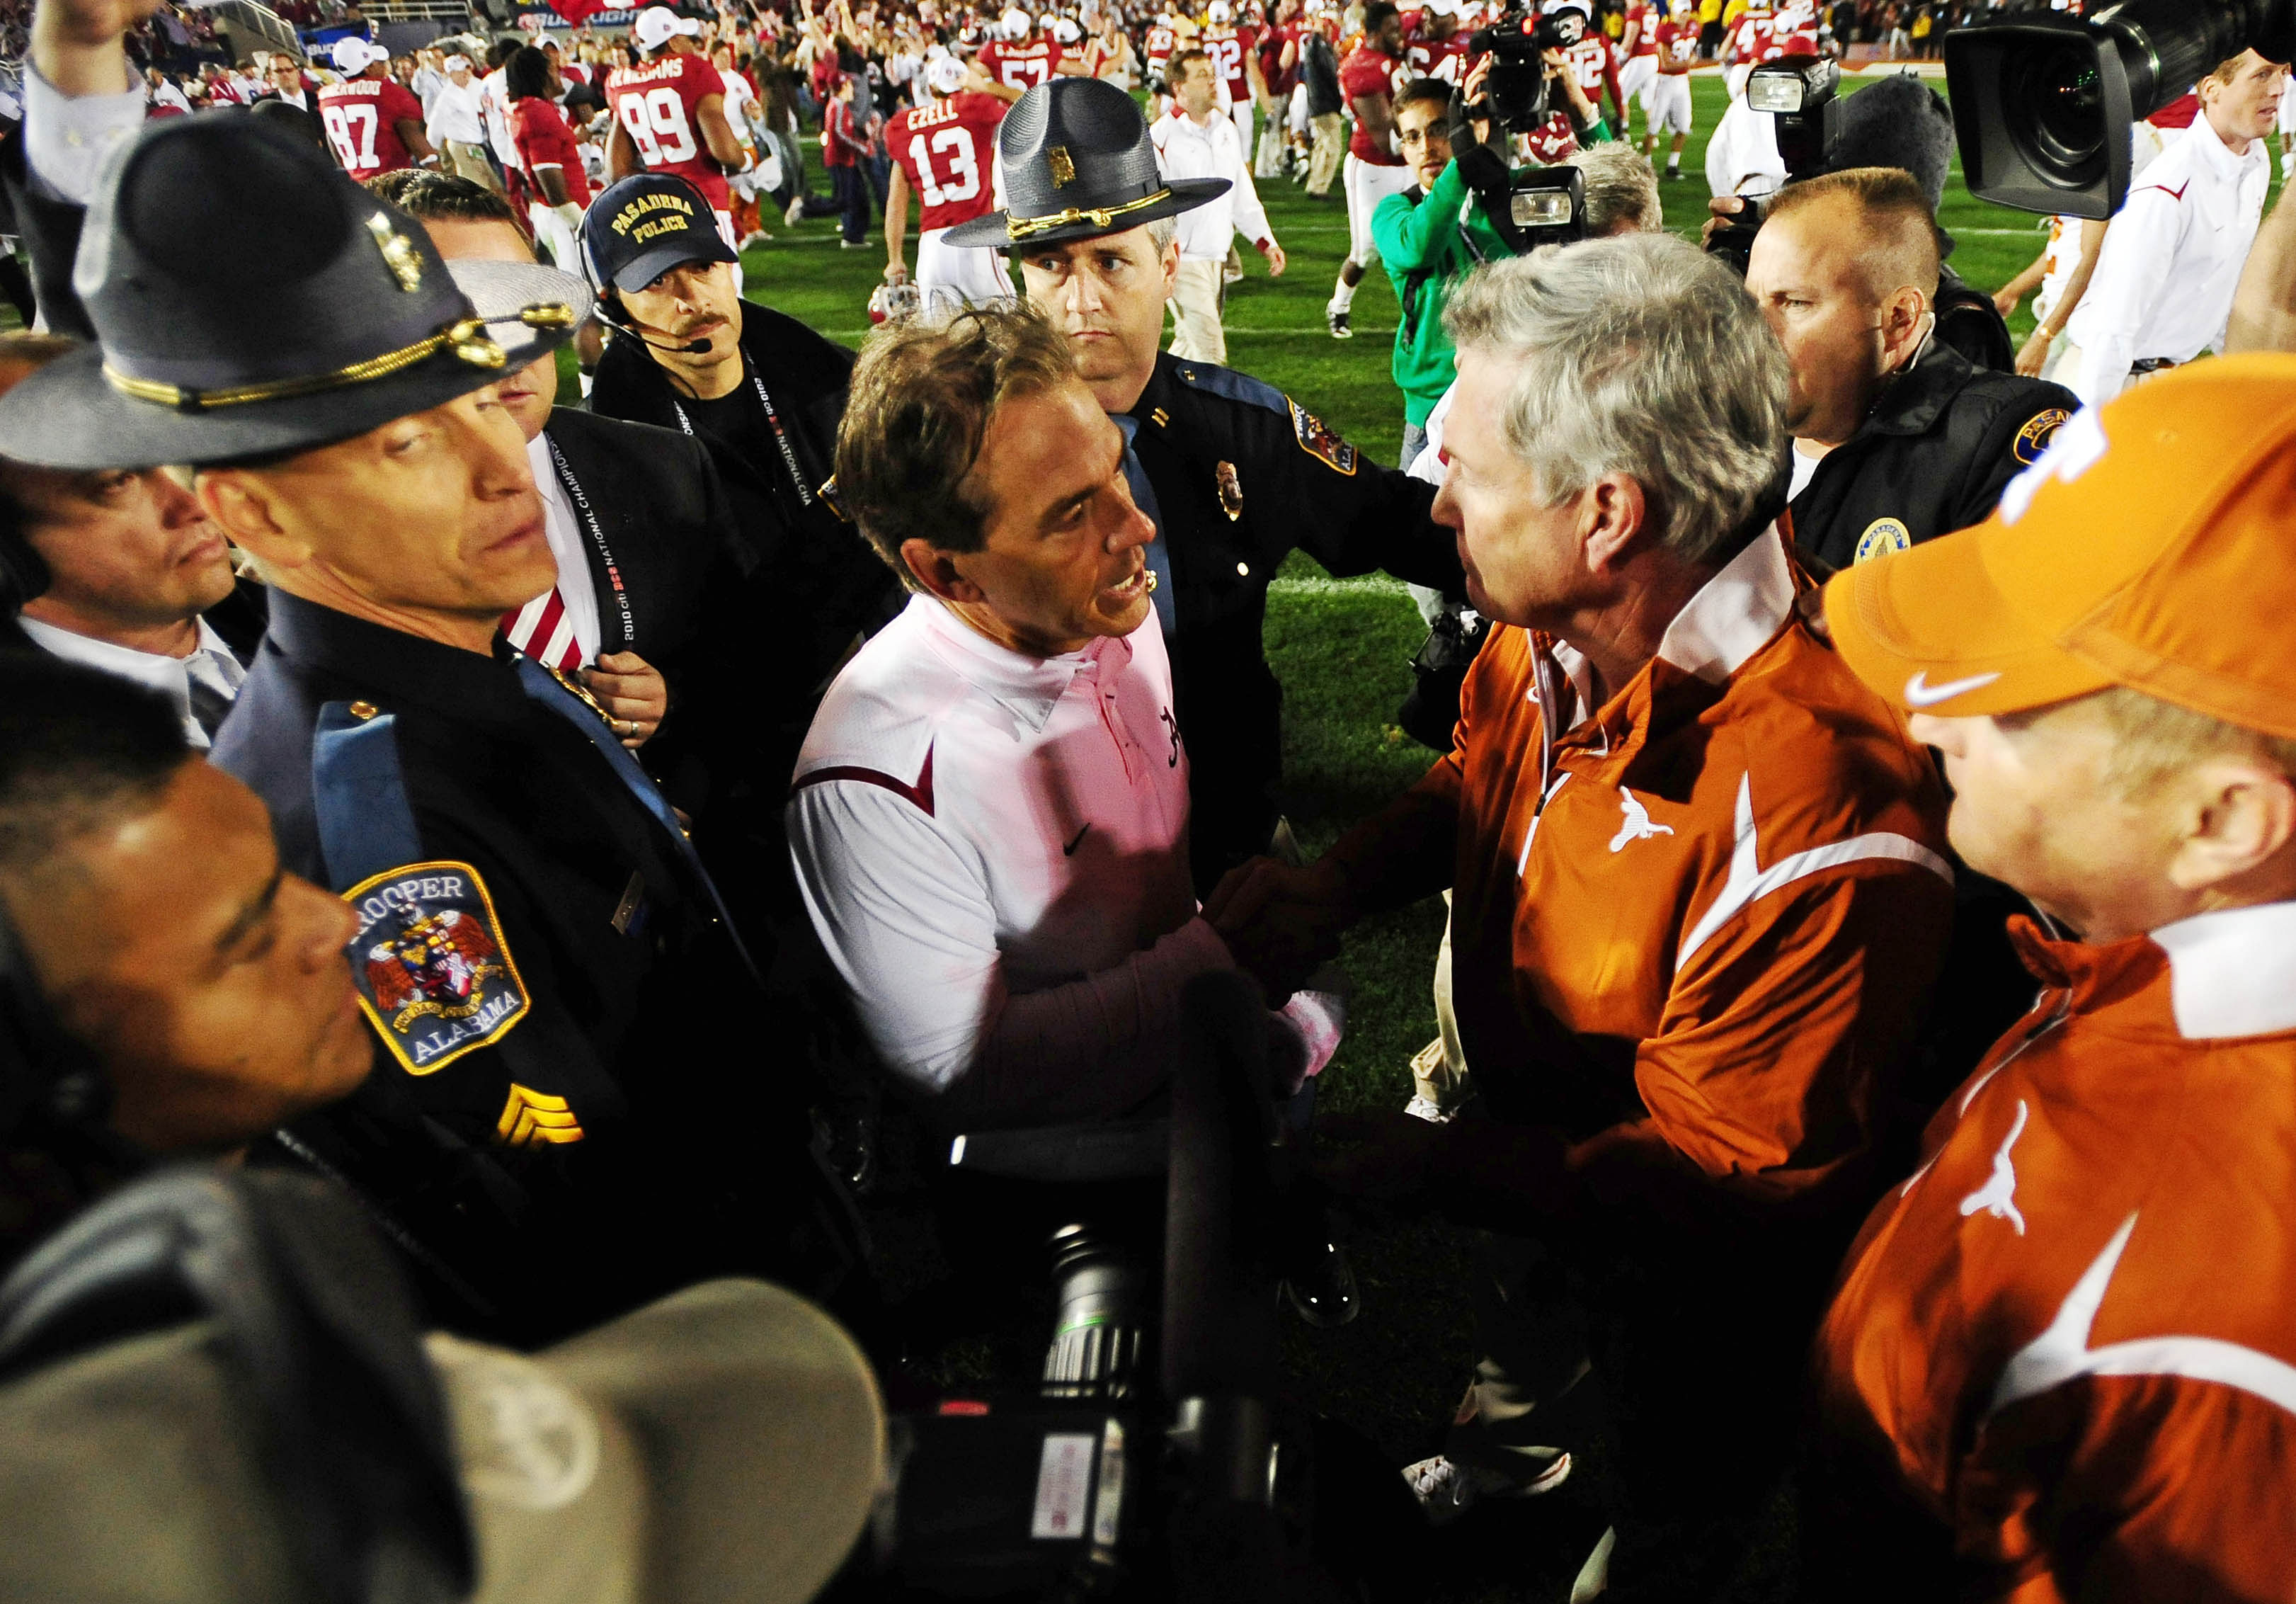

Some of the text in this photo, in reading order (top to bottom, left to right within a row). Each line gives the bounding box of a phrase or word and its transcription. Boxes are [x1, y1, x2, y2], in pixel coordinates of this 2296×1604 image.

[1001, 57, 1048, 92] 57
[323, 103, 380, 170] 87
[619, 87, 697, 166] 89
[907, 98, 959, 132] EZELL
[908, 125, 981, 207] 13
[611, 193, 695, 237] PASADENA
[632, 215, 689, 244] POLICE
[777, 435, 803, 484] NATIONAL
[585, 509, 615, 567] NATIONAL
[621, 610, 635, 641] 2010
[412, 991, 520, 1064] ALABAMA
